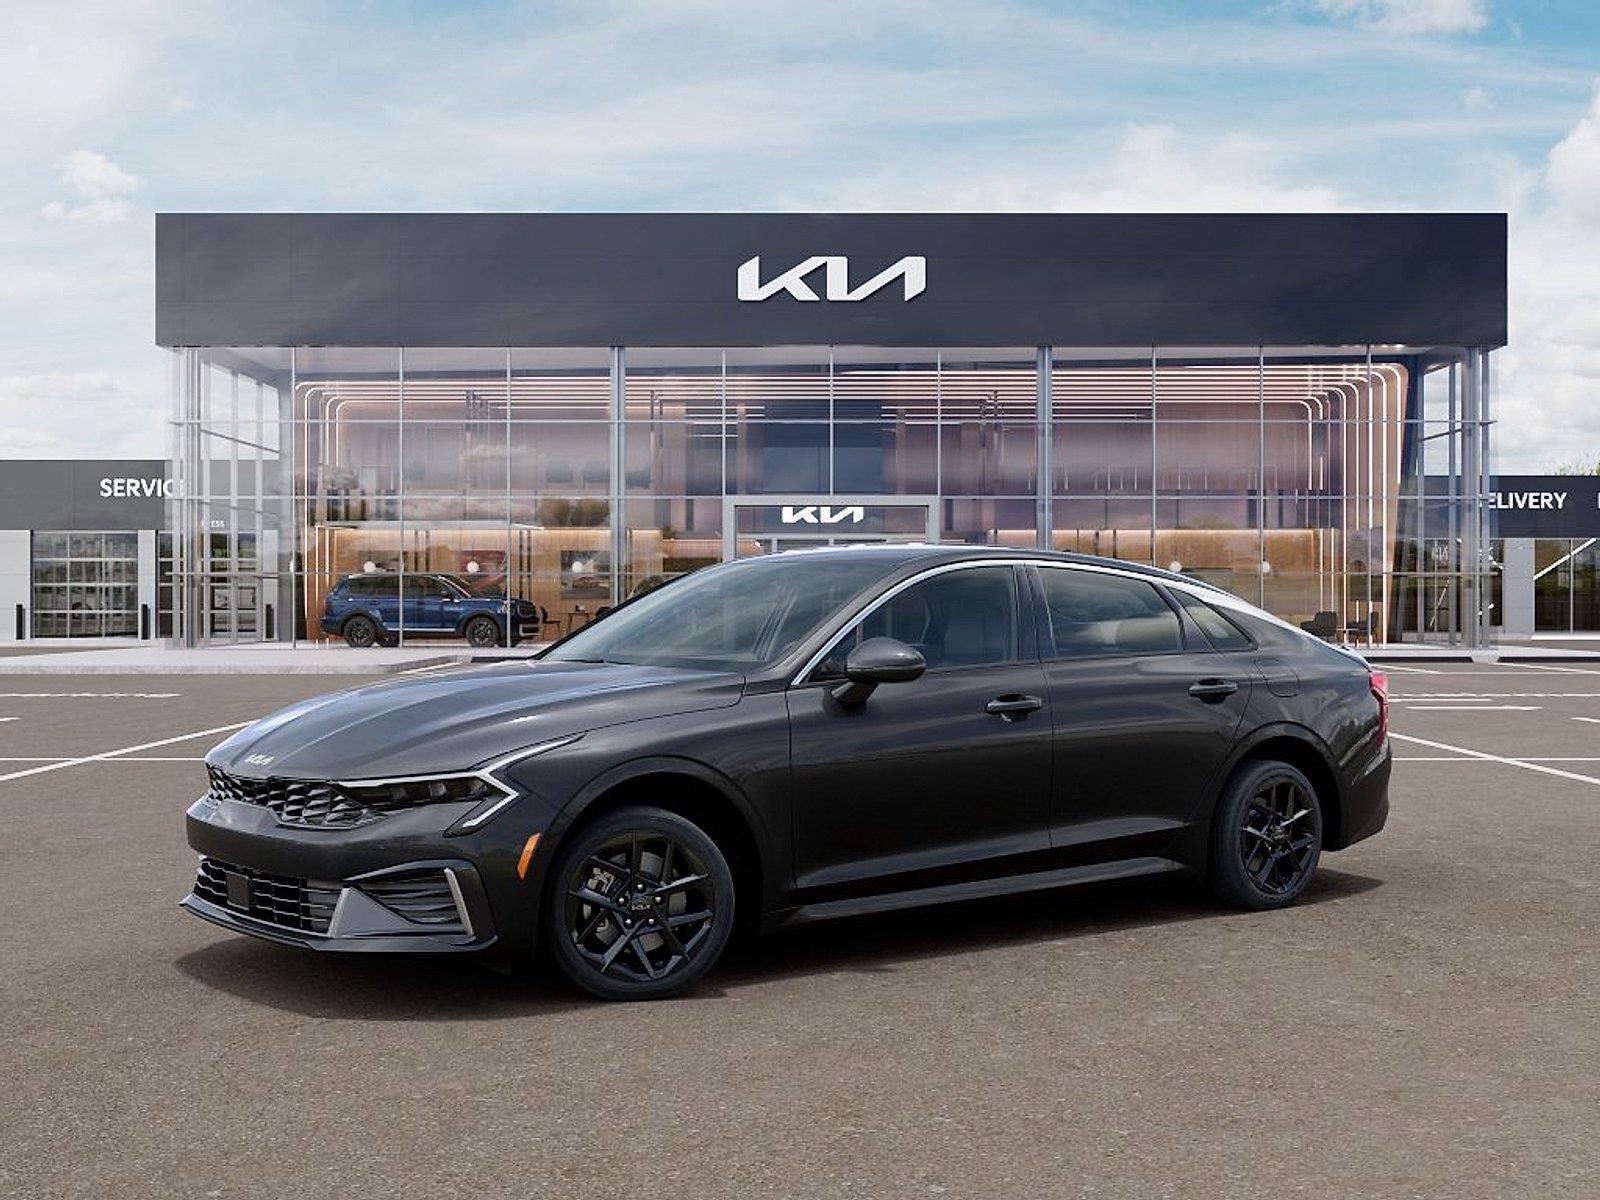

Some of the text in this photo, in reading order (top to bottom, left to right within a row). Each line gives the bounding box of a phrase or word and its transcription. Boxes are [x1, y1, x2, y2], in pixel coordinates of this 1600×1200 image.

[737, 255, 927, 302] KIA
[1479, 491, 1567, 510] ELIVERY
[782, 506, 864, 524] KIA
